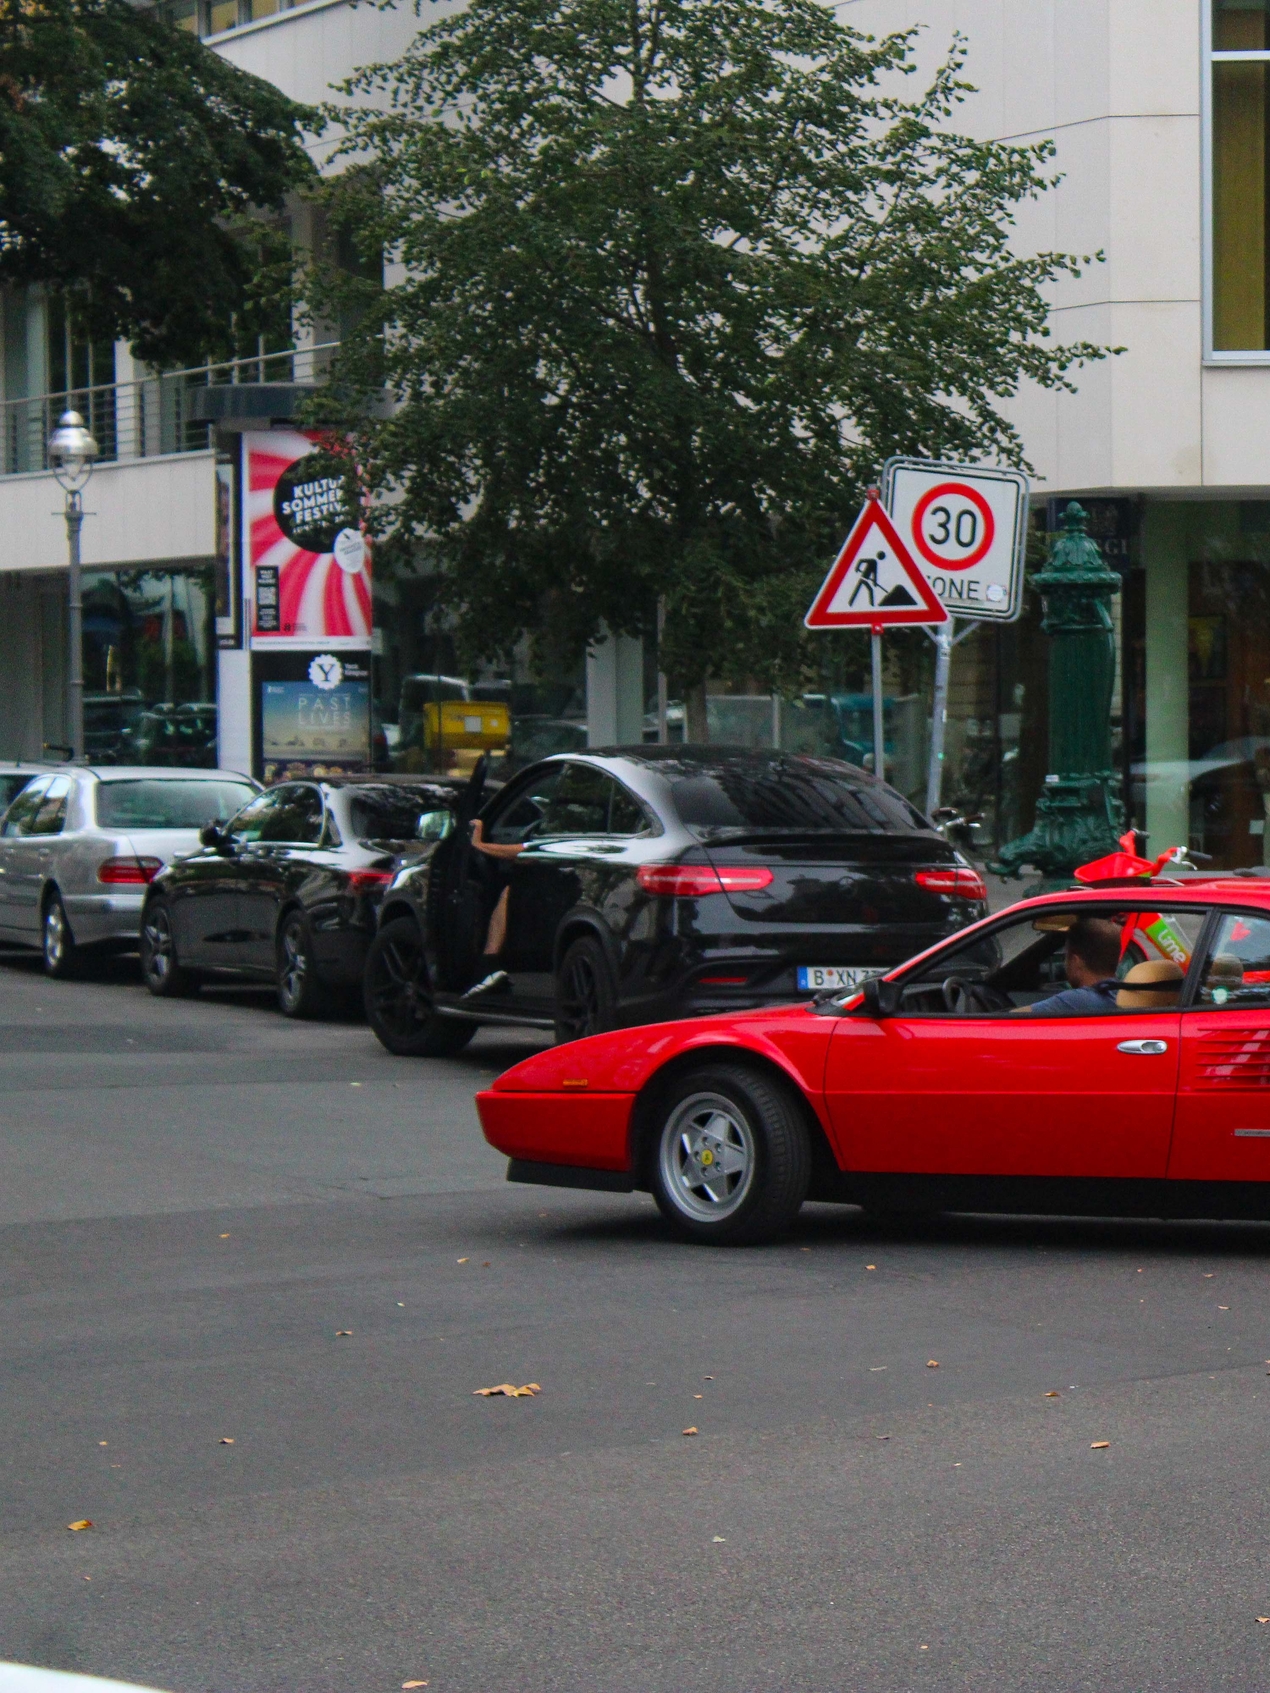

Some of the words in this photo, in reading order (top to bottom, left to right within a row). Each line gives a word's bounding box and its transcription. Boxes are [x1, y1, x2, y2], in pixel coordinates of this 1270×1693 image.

[295, 501, 350, 524] FESTIV
[928, 505, 977, 548] 30
[926, 575, 981, 601] ONE
[298, 696, 351, 711] PAST
[299, 711, 351, 726] LIVES
[814, 969, 825, 986] B
[836, 969, 857, 986] XN
